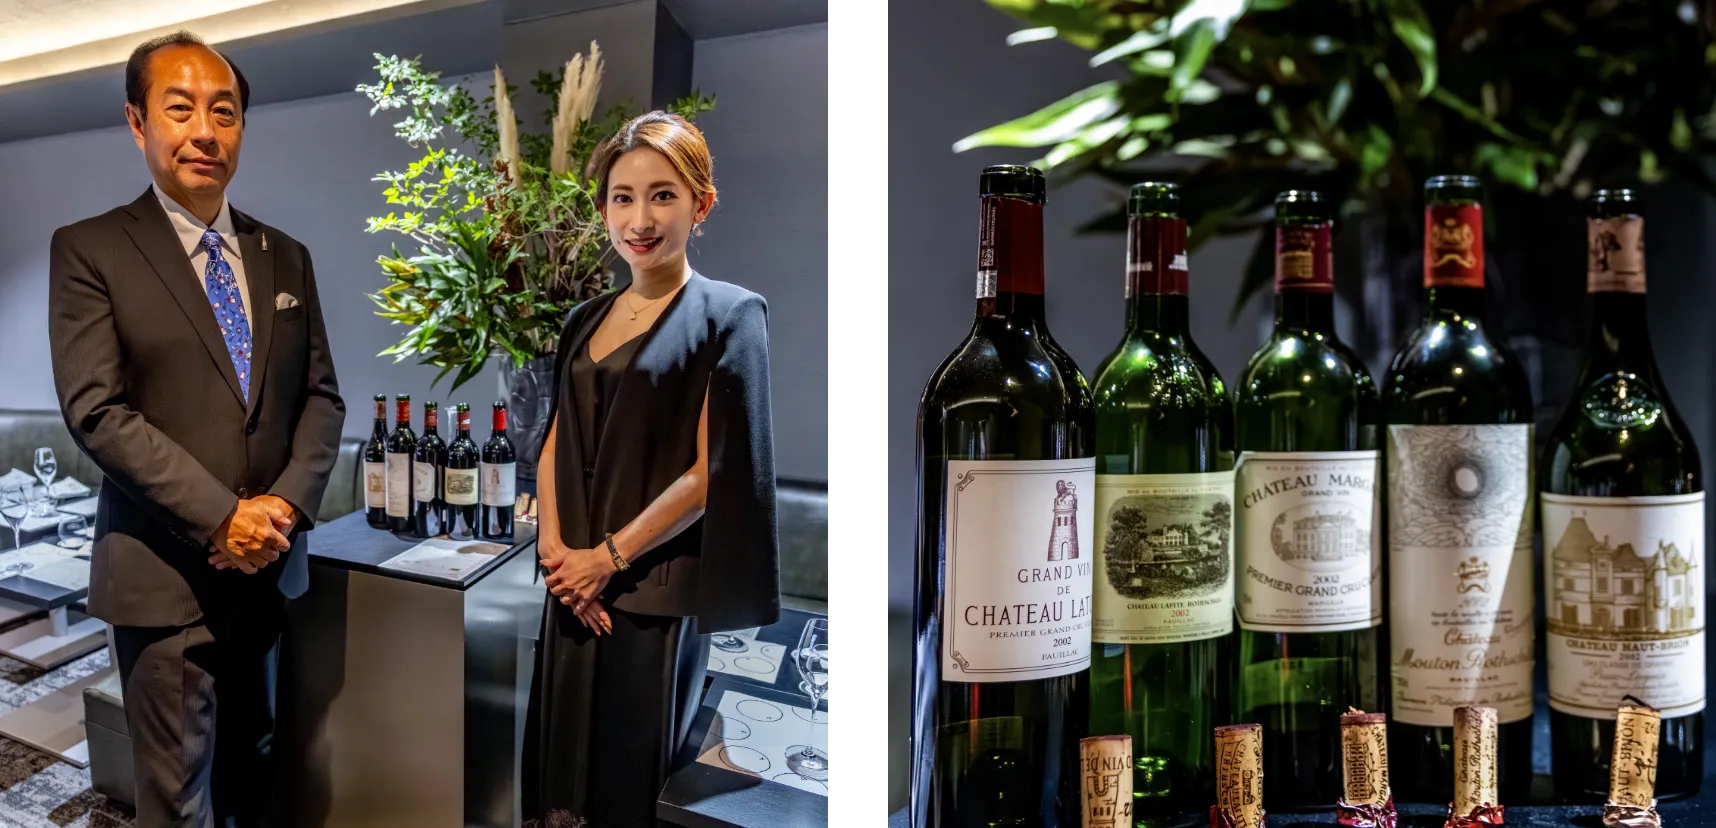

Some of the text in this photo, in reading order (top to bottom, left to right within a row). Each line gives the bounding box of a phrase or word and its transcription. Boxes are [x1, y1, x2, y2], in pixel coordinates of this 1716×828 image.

[1328, 473, 1375, 492] MARG
[1017, 564, 1073, 584] GRAND
[1246, 564, 1293, 594] PREMIER
[1294, 584, 1338, 597] GRAND
[1057, 585, 1072, 596] DE
[964, 595, 1092, 627] CHATEAU LAT
[1126, 601, 1159, 610] CHATEAU
[1160, 601, 1184, 609] LAFITE
[1170, 609, 1190, 618] 2002
[989, 629, 1037, 639] PREMIER
[1039, 626, 1071, 636] GRAND
[1052, 636, 1072, 647] 2002
[1041, 648, 1079, 660] PAUILLAC
[1102, 756, 1125, 771] VIN
[1375, 769, 1388, 807] MARGAU
